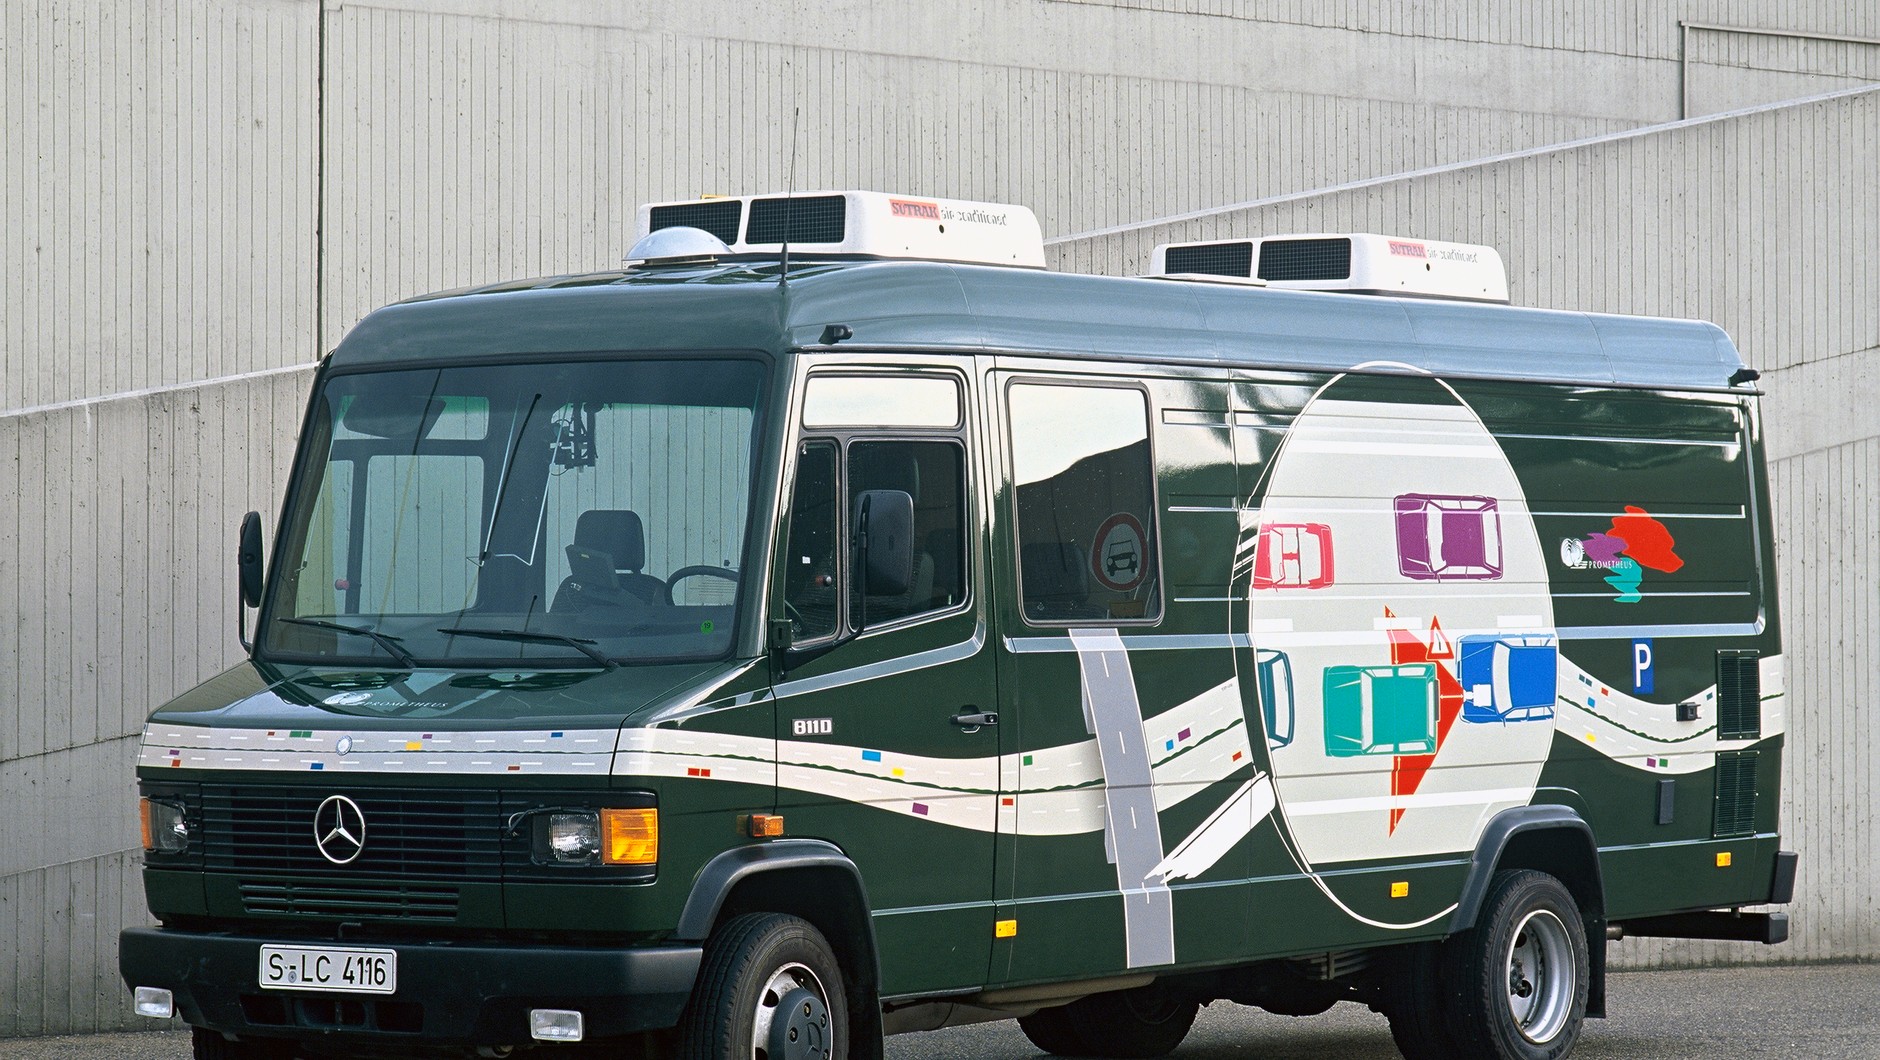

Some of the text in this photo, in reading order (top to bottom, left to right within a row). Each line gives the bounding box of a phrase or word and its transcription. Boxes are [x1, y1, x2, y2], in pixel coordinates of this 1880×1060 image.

[891, 202, 939, 219] SUTRAK
[1389, 243, 1426, 258] SUTRAK
[1588, 560, 1633, 570] PROMETHEUS
[1635, 643, 1652, 688] P
[794, 719, 832, 735] 811D
[342, 956, 386, 986] 4116
